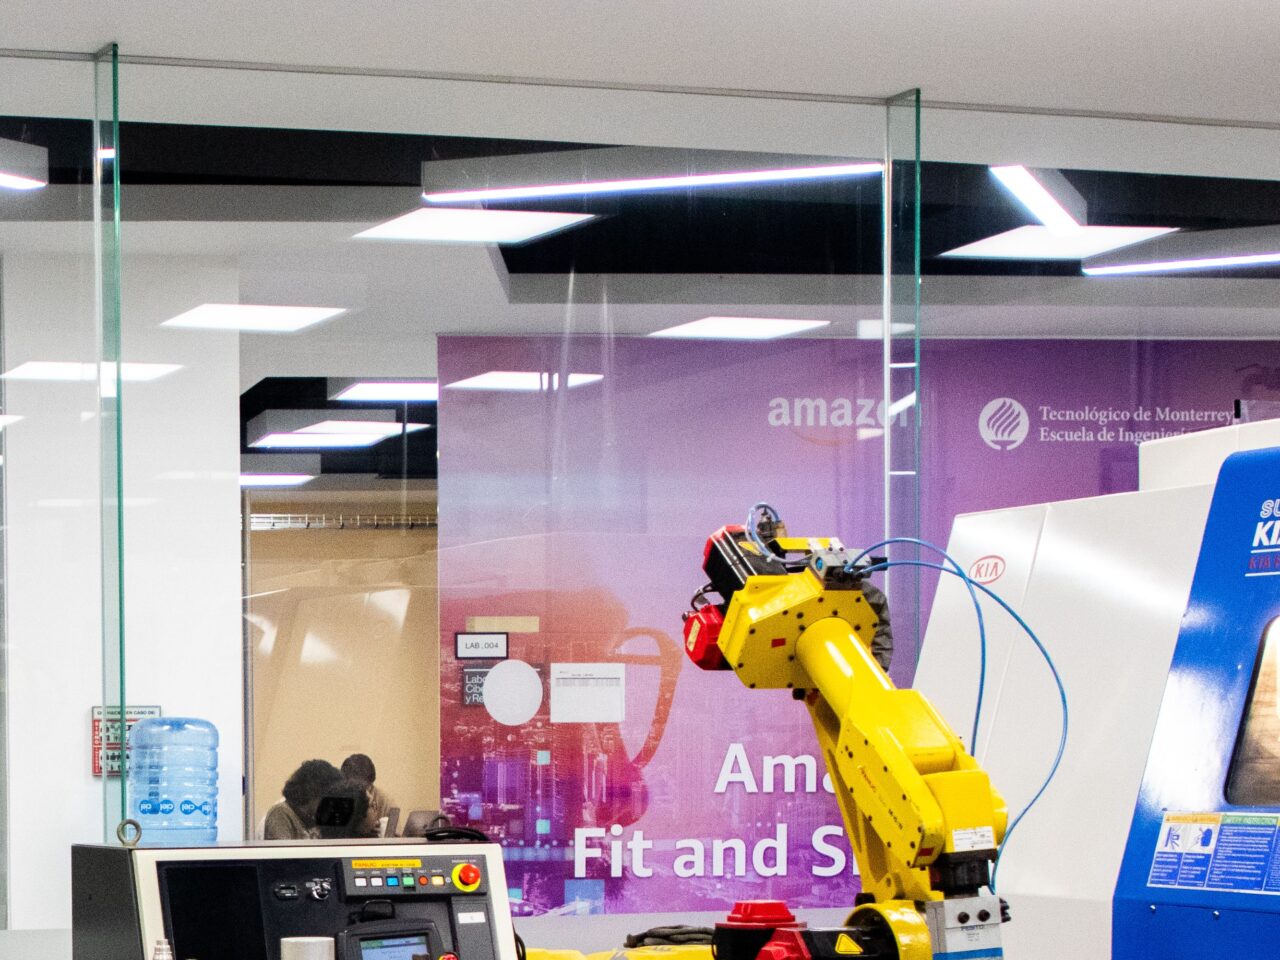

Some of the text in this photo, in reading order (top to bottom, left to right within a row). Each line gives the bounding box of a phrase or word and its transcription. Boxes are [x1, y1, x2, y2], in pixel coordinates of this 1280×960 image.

[1038, 404, 1233, 424] Tecnológico de Monterrey
[1039, 426, 1095, 443] Escuela
[1097, 426, 1115, 443] de
[1252, 520, 1280, 547] KI
[974, 561, 999, 579] KIA
[714, 743, 835, 794] Am
[573, 824, 653, 878] Fit
[673, 823, 788, 878] and
